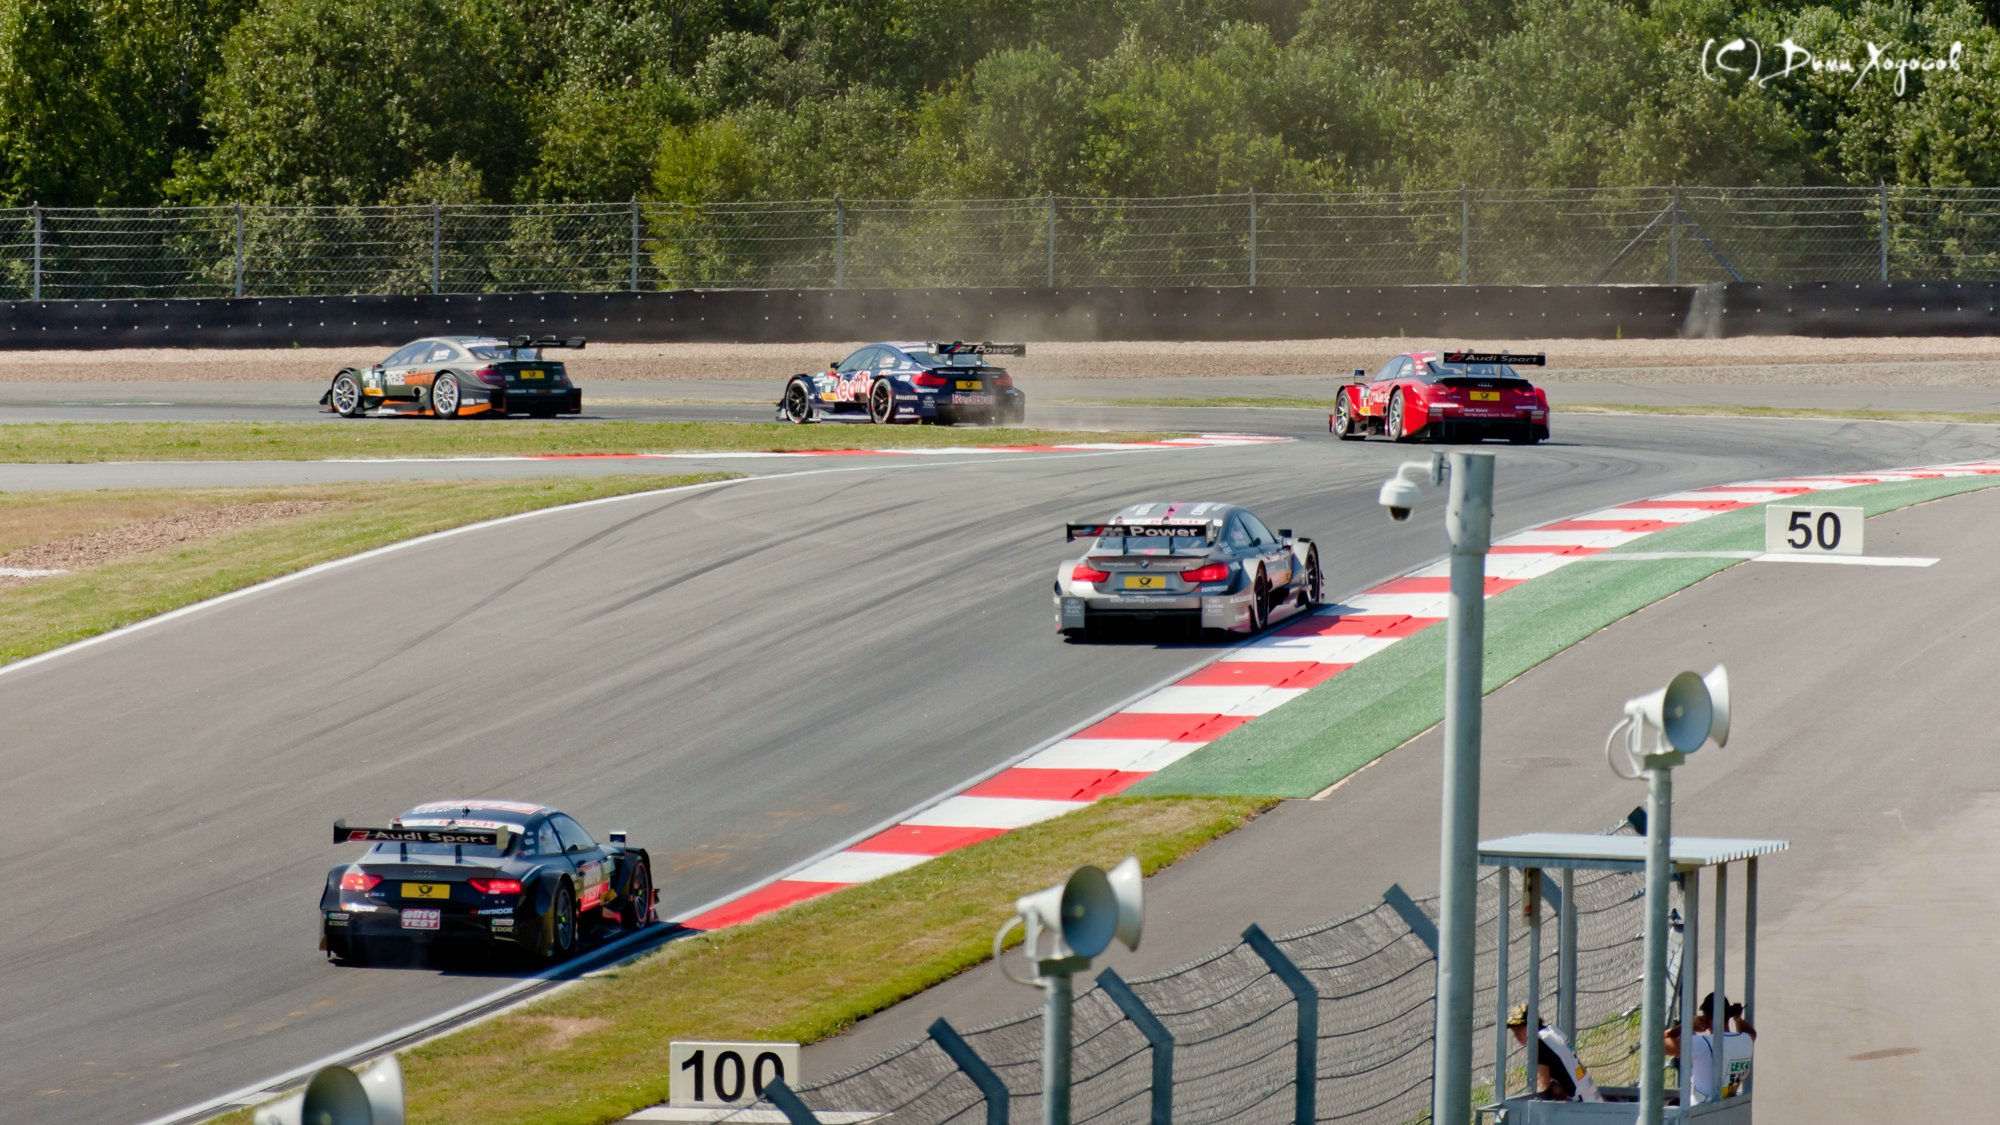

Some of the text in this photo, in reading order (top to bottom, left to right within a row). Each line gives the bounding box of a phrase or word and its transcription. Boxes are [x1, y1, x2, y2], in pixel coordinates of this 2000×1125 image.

[974, 346, 1018, 354] Power
[1501, 355, 1538, 363] Sport
[1129, 526, 1198, 537] Power
[1787, 511, 1841, 550] 50
[438, 820, 495, 828] BSCH
[375, 831, 489, 844] Audi Sport
[682, 1049, 784, 1103] 100
